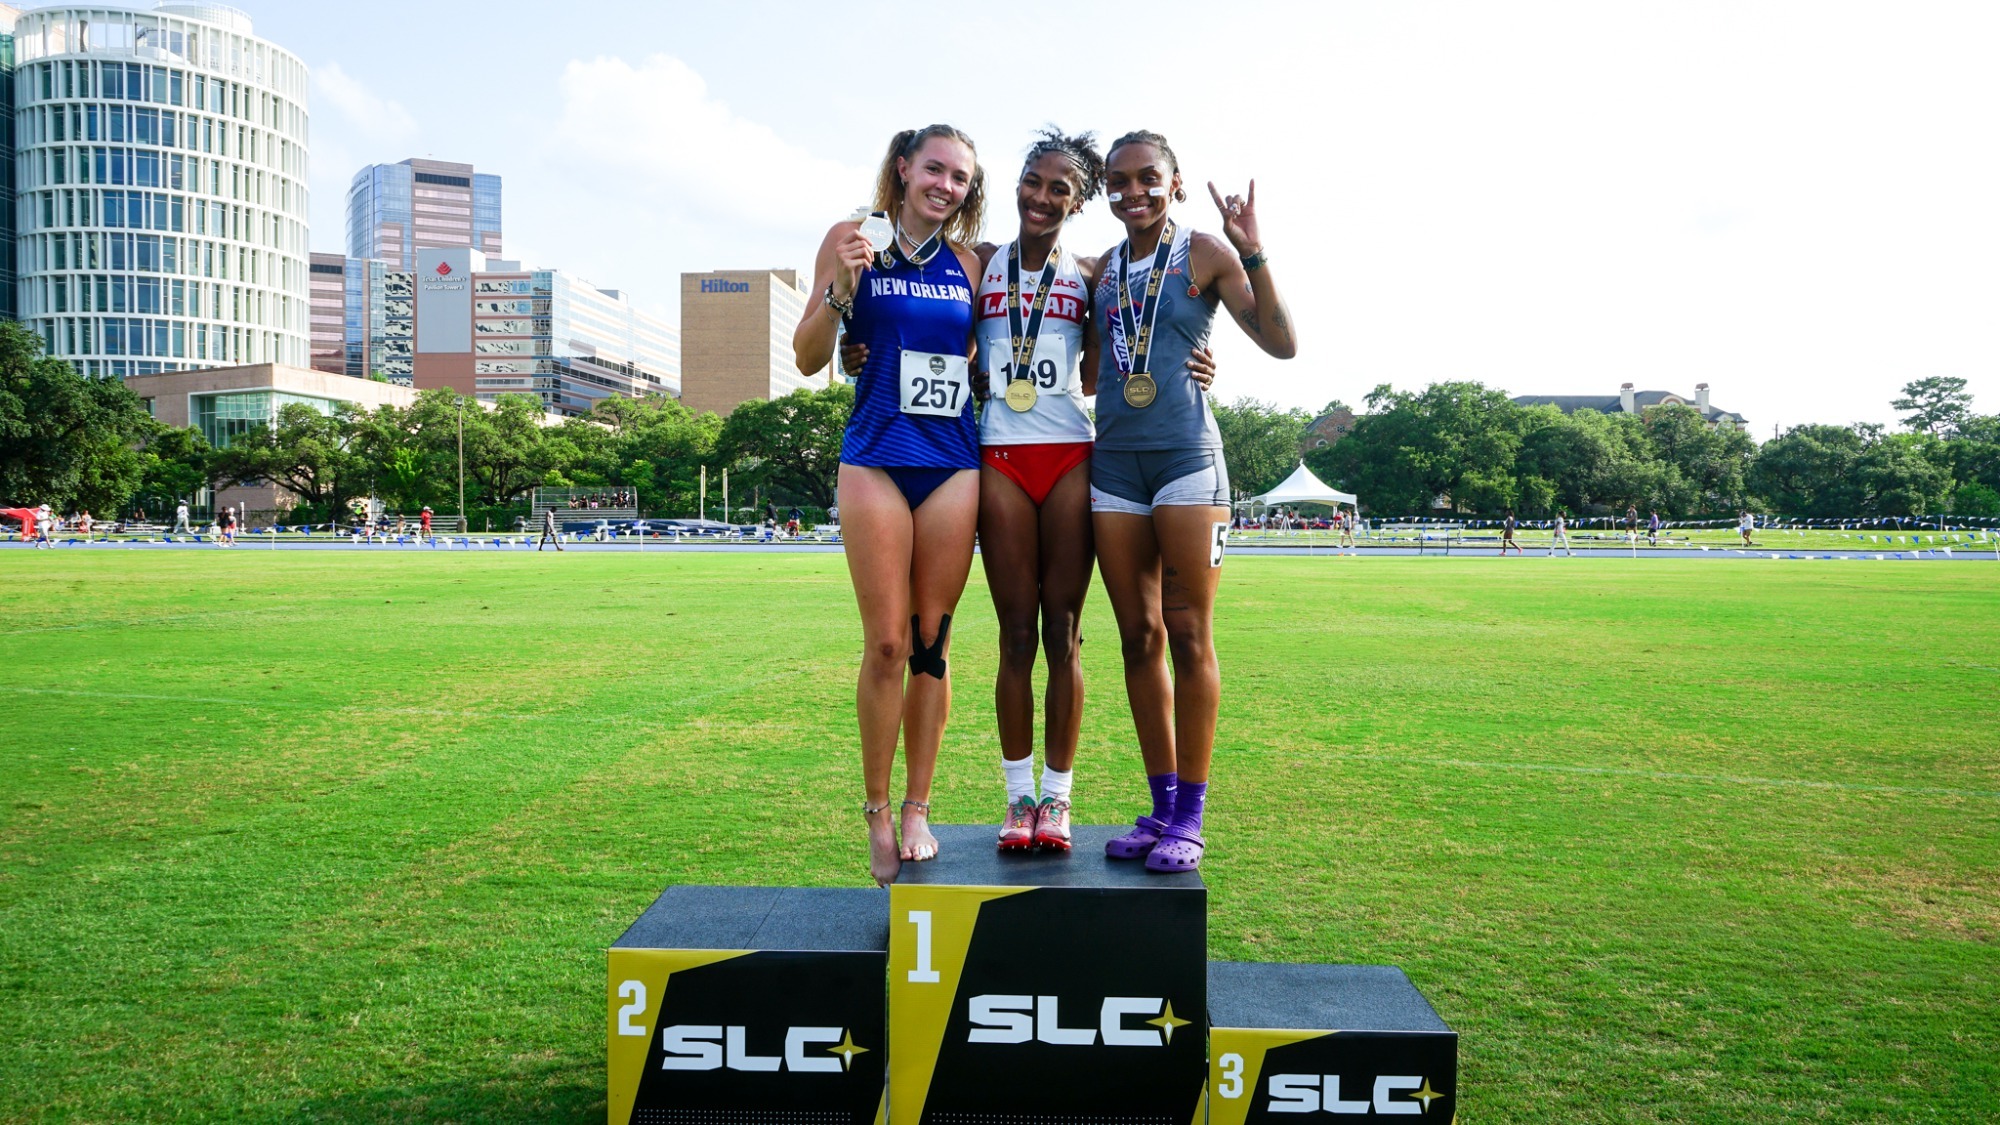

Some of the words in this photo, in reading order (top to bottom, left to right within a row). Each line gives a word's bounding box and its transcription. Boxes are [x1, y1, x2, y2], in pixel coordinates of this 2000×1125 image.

[701, 279, 749, 293] Hilton
[871, 278, 907, 297] NEW
[910, 282, 971, 305] ORLEANS
[1009, 283, 1018, 309] SLC
[1034, 284, 1047, 310] SLC
[1054, 279, 1080, 289] SLC
[1148, 267, 1161, 297] SLC
[1021, 336, 1033, 365] SLC
[1138, 325, 1149, 355] SLC
[911, 377, 960, 411] 257
[1130, 387, 1150, 395] SLC
[1214, 526, 1226, 565] 5
[908, 911, 940, 983] 1
[618, 980, 647, 1036] 2
[967, 994, 1164, 1047] SLC
[662, 1025, 844, 1072] SLC
[1218, 1053, 1244, 1099] 3
[1267, 1074, 1424, 1115] SLC
